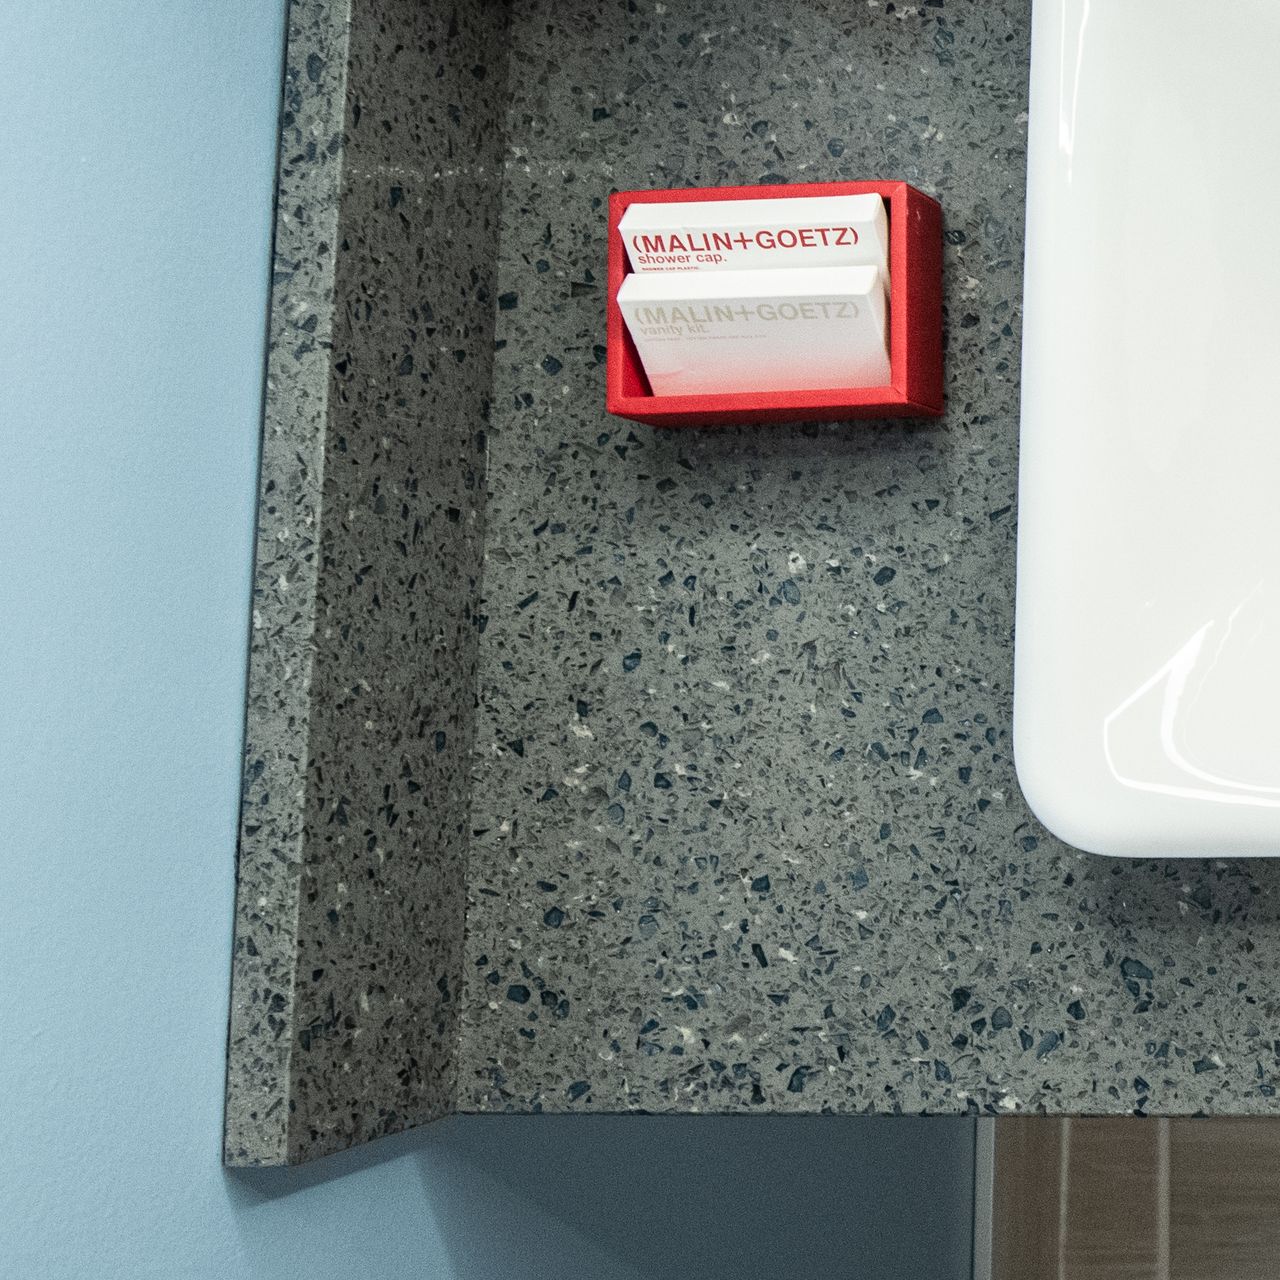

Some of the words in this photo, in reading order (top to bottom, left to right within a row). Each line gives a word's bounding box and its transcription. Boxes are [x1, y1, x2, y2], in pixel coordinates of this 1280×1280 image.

[632, 226, 859, 253] (MALIN+GOETZ)
[638, 253, 691, 265] shower
[696, 253, 728, 265] cap.
[634, 301, 860, 325] (MALIN+GOETZ)
[640, 324, 682, 336] vanity
